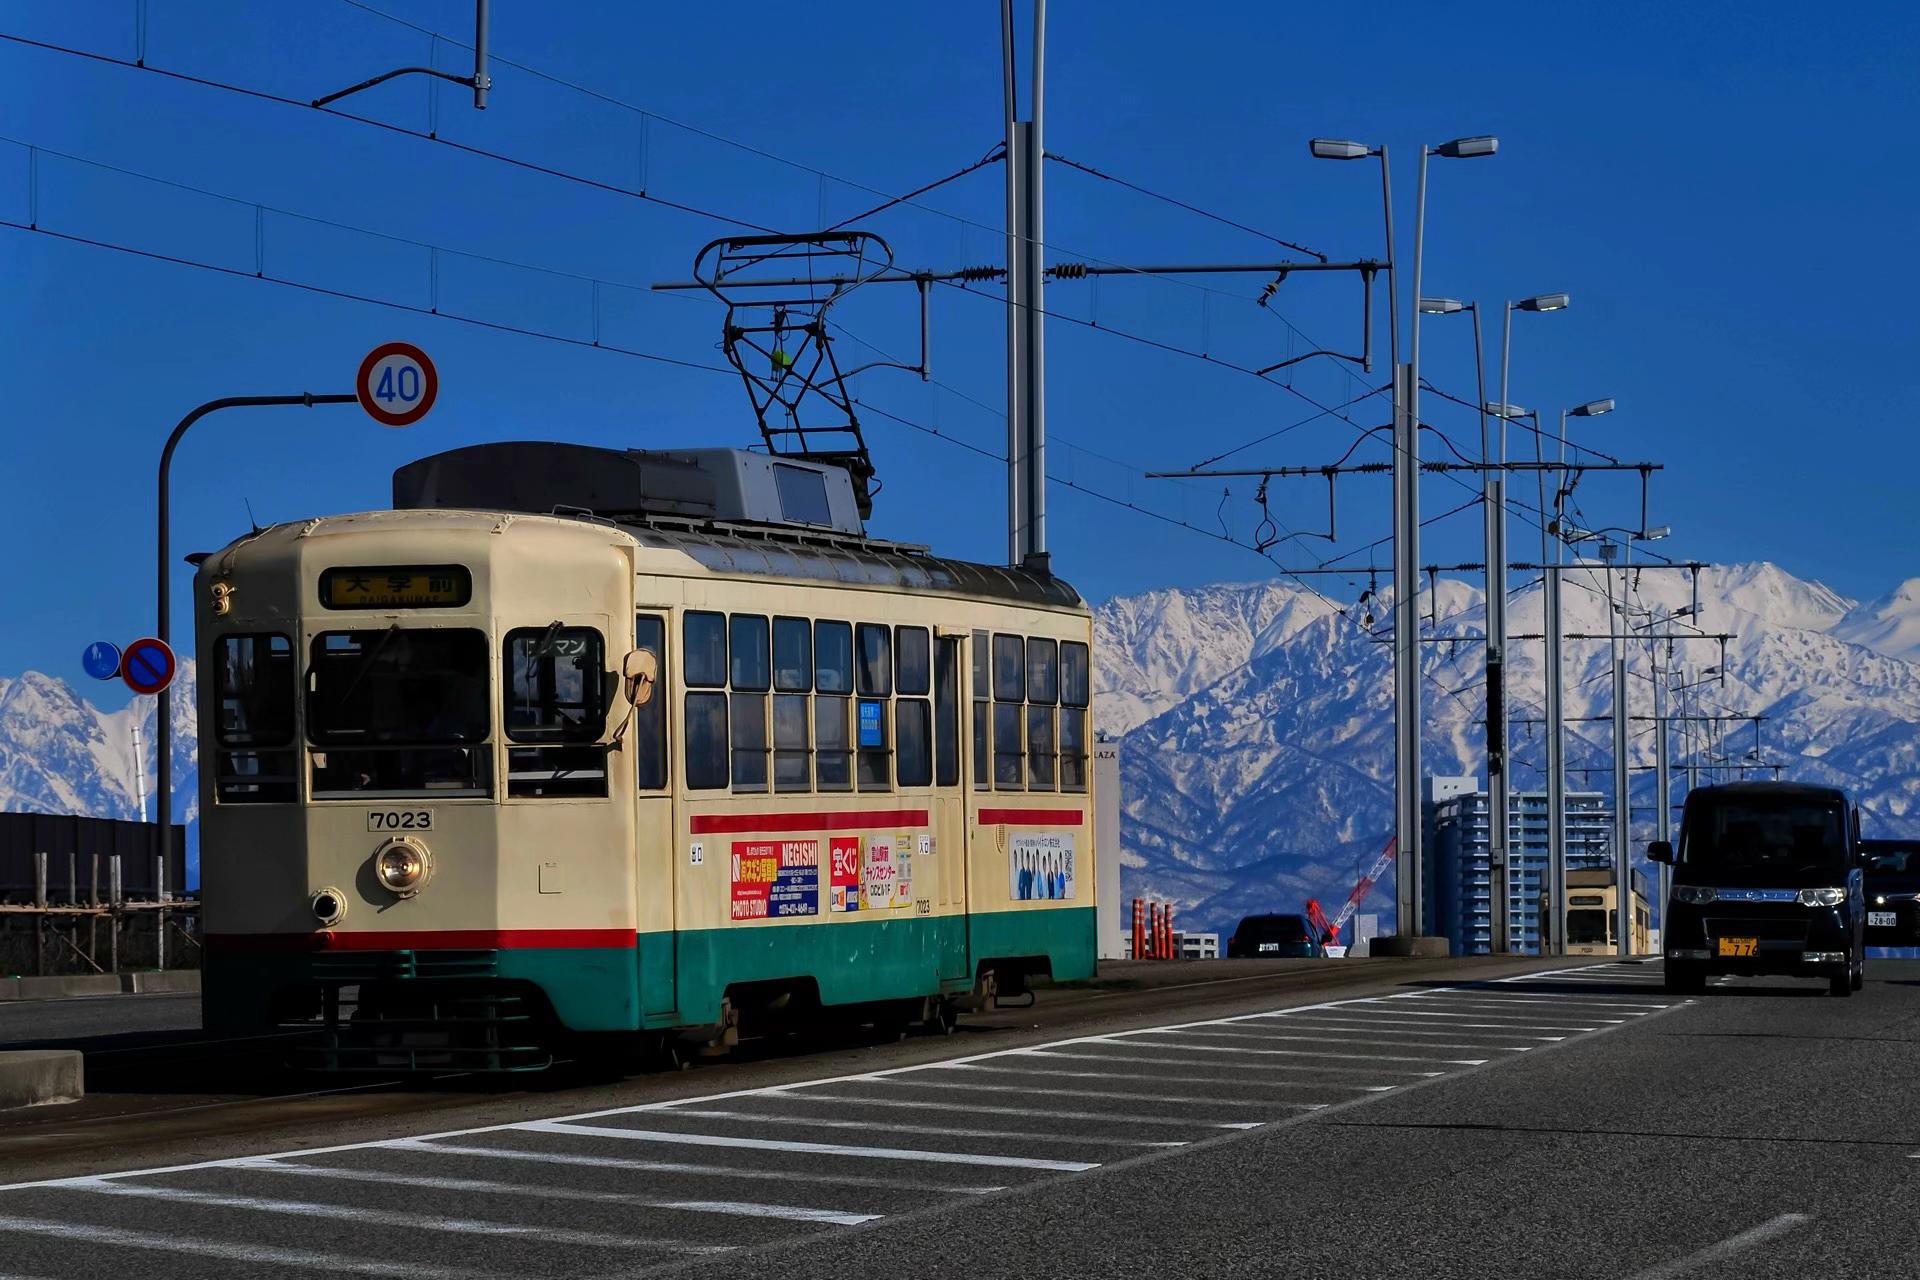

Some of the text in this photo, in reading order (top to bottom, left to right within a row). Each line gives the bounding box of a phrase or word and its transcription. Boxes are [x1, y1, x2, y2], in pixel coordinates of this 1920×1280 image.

[376, 366, 419, 402] 40
[345, 576, 454, 593] 大学前
[370, 811, 430, 829] 7023
[782, 842, 817, 867] NEGISHI
[832, 847, 857, 877] 宝くじ
[866, 865, 896, 881] チャンスセンター
[732, 898, 767, 918] PHOTO STUDIO
[916, 899, 930, 914] 7023
